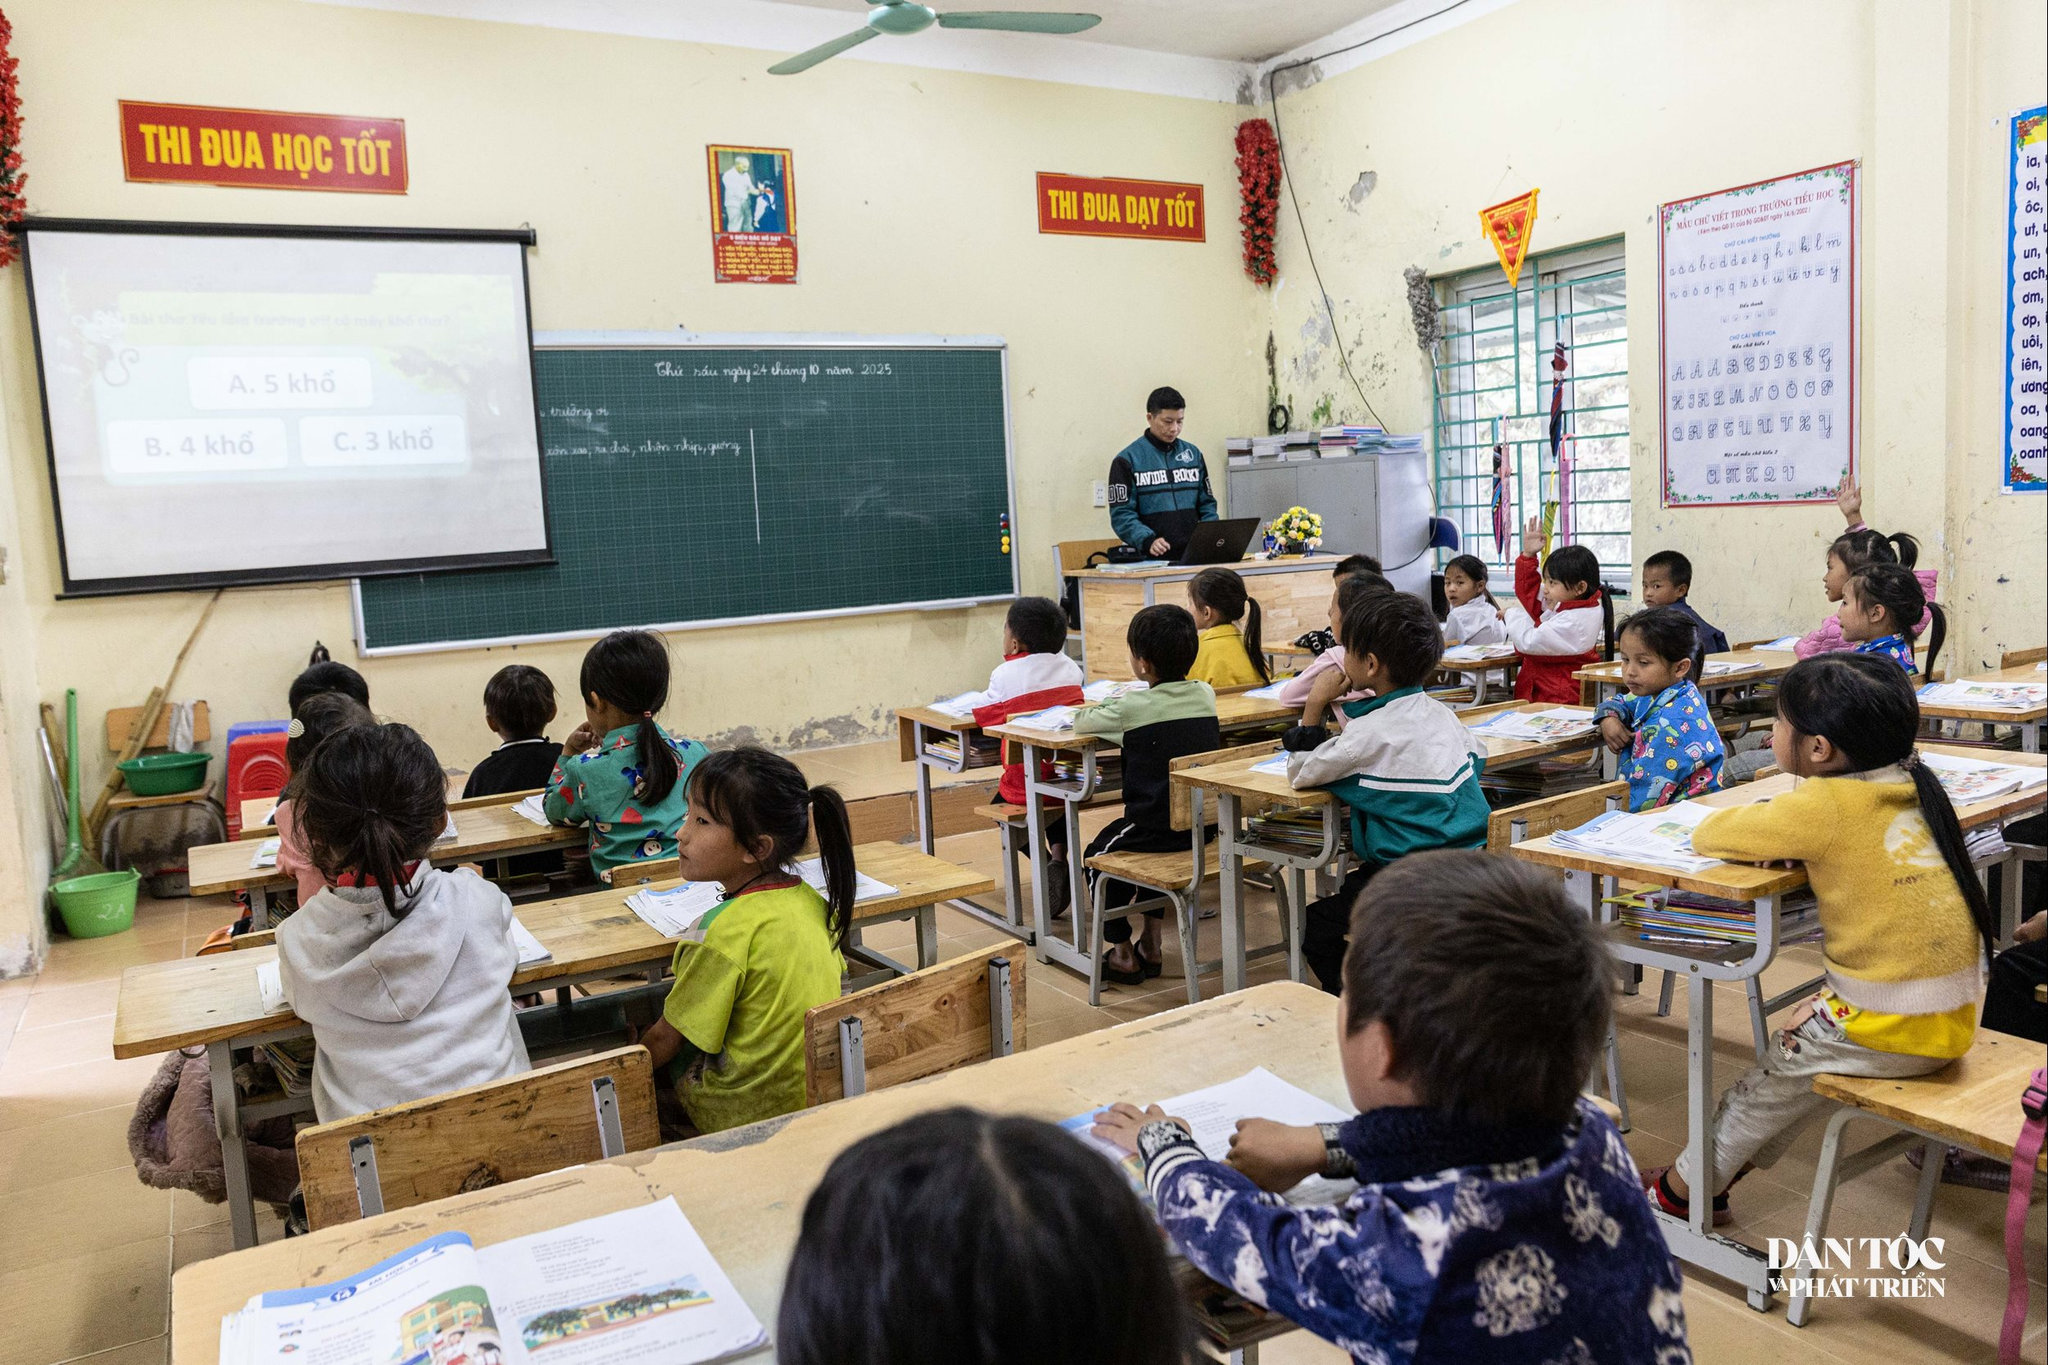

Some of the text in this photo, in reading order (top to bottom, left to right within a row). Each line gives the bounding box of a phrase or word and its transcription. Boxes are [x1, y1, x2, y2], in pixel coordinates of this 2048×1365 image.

[139, 124, 392, 180] THI ĐUA HỌC TỐT
[2026, 155, 2041, 169] ia,
[2026, 177, 2040, 192] oi,
[1048, 189, 1195, 230] THI ĐUA DẠY TỐT
[1731, 206, 1757, 219] TRONG
[1816, 189, 1835, 201] HỌC
[2023, 247, 2041, 260] un,
[229, 369, 336, 394] A. 5 khổ
[654, 361, 892, 383] Thứ sáu ngày 24 tháng 10 năm 2025
[2020, 403, 2039, 417] oa,
[145, 430, 254, 457] B. 4 khổ
[333, 425, 434, 451] C. 3 khổ
